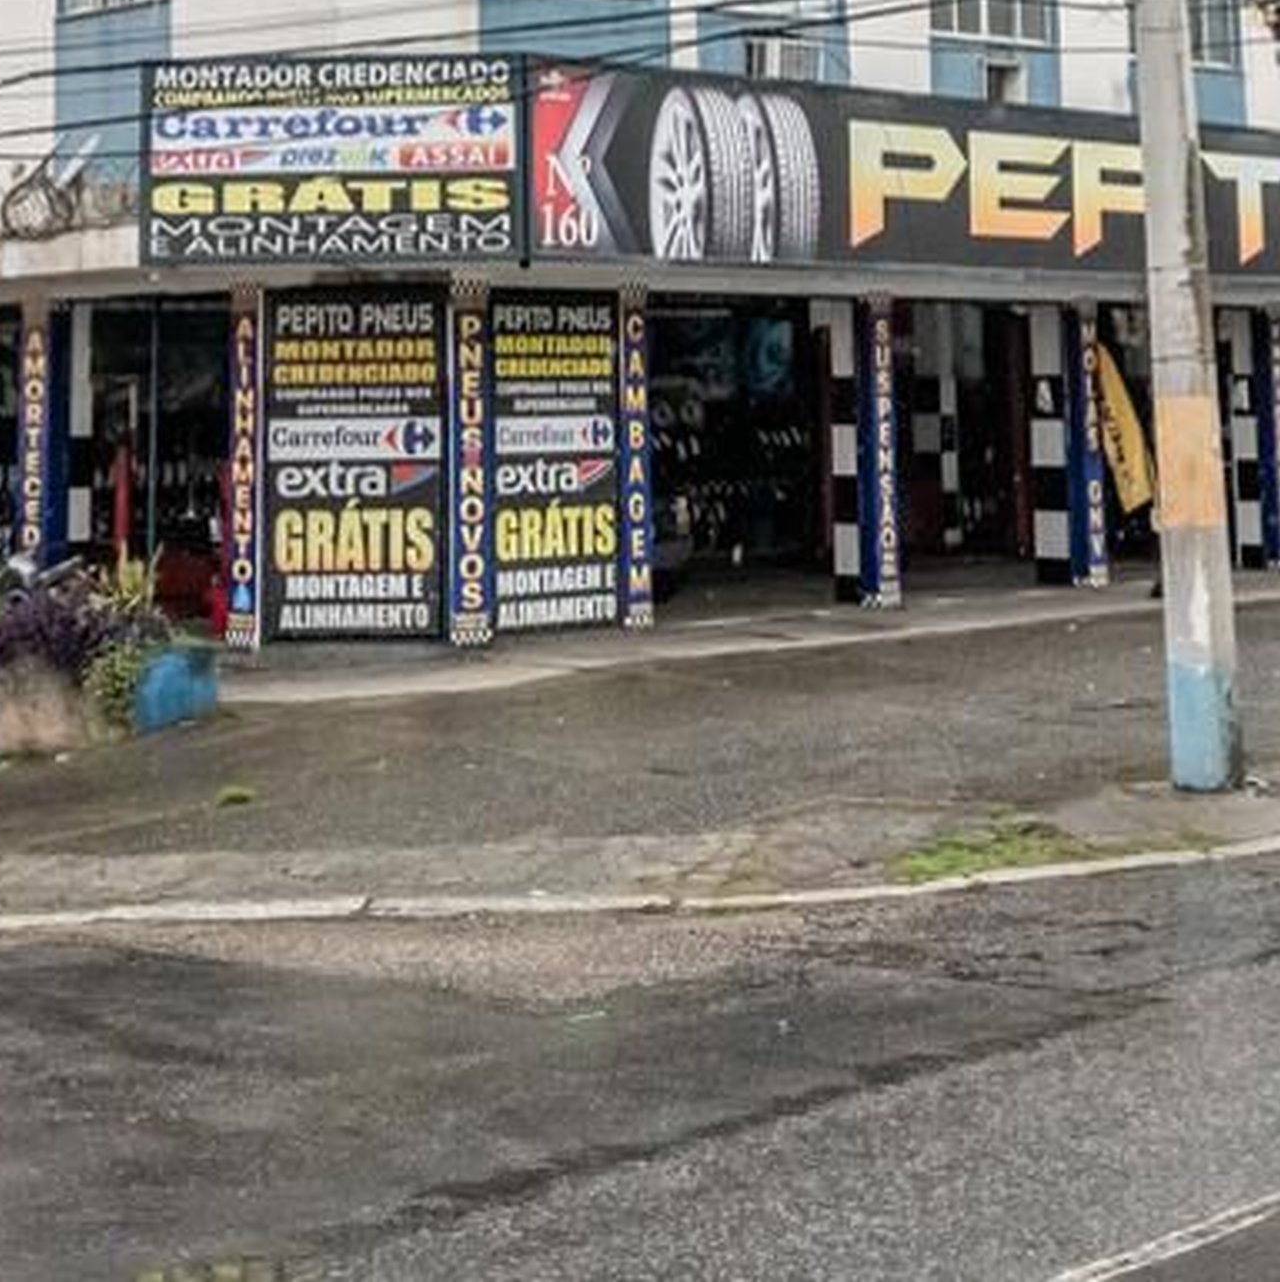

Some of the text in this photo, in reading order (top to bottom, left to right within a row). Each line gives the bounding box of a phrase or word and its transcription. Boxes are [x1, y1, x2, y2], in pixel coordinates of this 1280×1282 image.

[154, 65, 311, 89] MONTADOR
[318, 61, 510, 87] CREDENCIADO
[156, 108, 430, 140] Carrefour
[151, 214, 511, 237] MONTAGEM
[541, 204, 598, 246] 160
[151, 233, 511, 257] E ALINHAMENTO
[277, 302, 434, 334] PEPITO PNEUS
[493, 304, 611, 332] PEPITO PNEUS
[274, 339, 435, 361] MONTADOR
[496, 334, 611, 355] MONTADOR
[274, 363, 437, 385] CREDENCIADO
[496, 358, 612, 377] CREDENCIADO
[233, 318, 253, 582] ALINHAMENTO
[272, 425, 381, 448] Carrefour
[460, 316, 484, 609] PNEUS NOVOS
[626, 316, 651, 591] CAMBAGEM
[276, 462, 388, 498] extra
[496, 458, 579, 494] extra
[275, 498, 435, 573] GRÁTIS
[496, 497, 616, 562] GRÁTIS
[285, 574, 424, 600] MONTAGEM E
[497, 565, 601, 597] MONTAGEM
[278, 603, 431, 631] ALINHAMENTO
[497, 594, 617, 630] ALINHAMENTO
